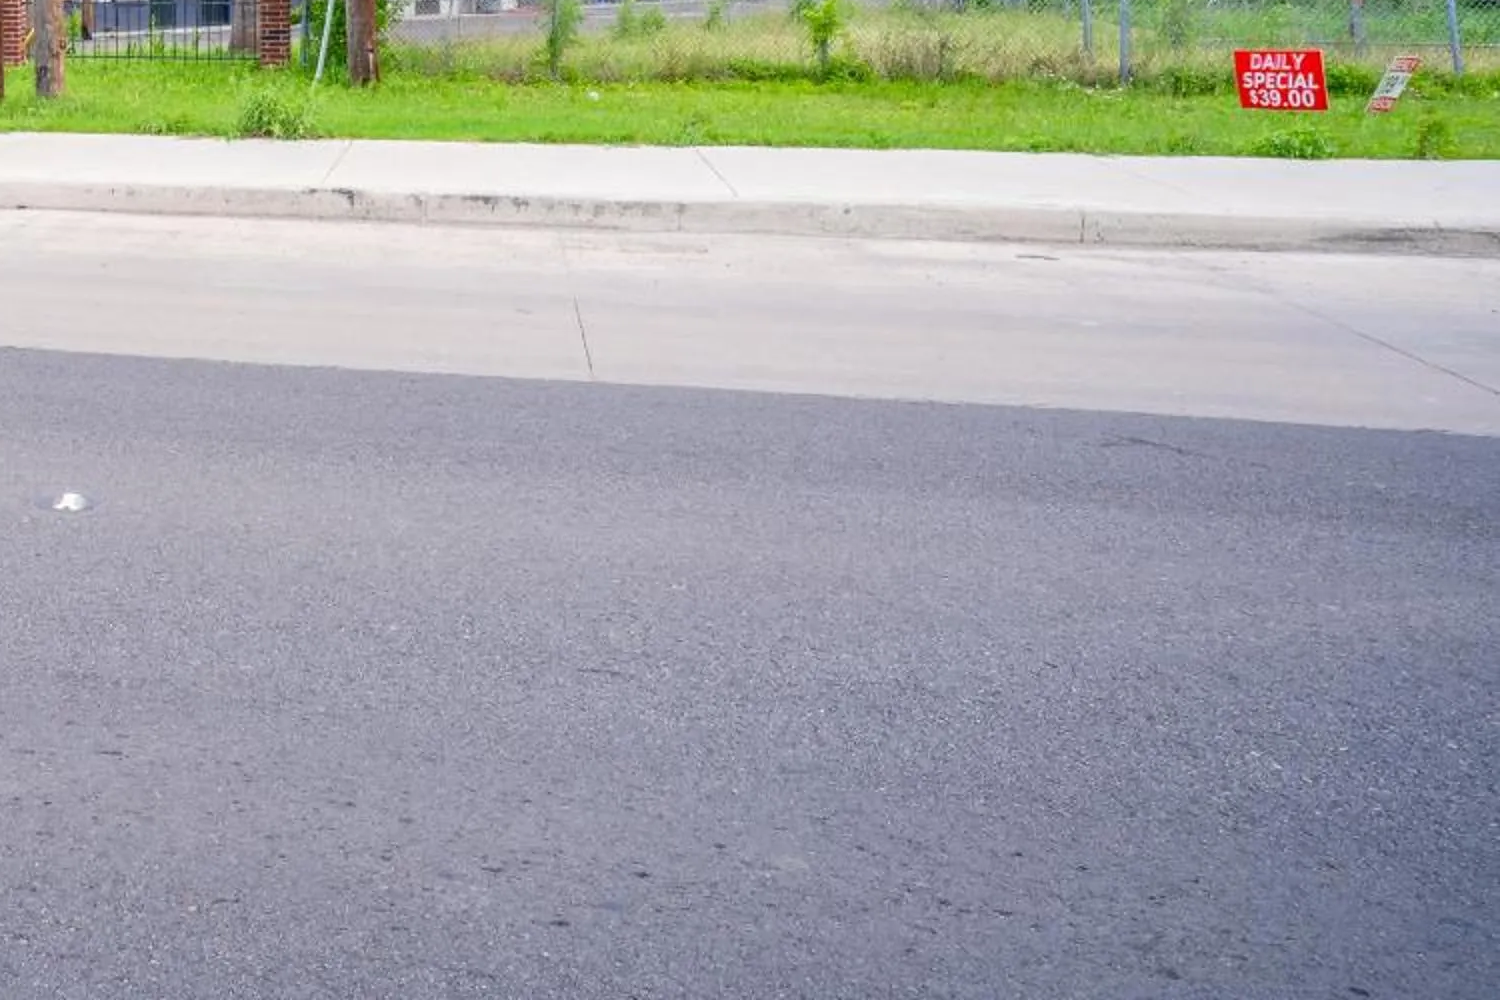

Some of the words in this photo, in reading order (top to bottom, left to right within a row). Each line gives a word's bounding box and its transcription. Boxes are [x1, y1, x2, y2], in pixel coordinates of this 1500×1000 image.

[1250, 53, 1307, 71] DAILY
[1242, 72, 1320, 89] SPECIAL
[1249, 89, 1315, 107] $39.00
